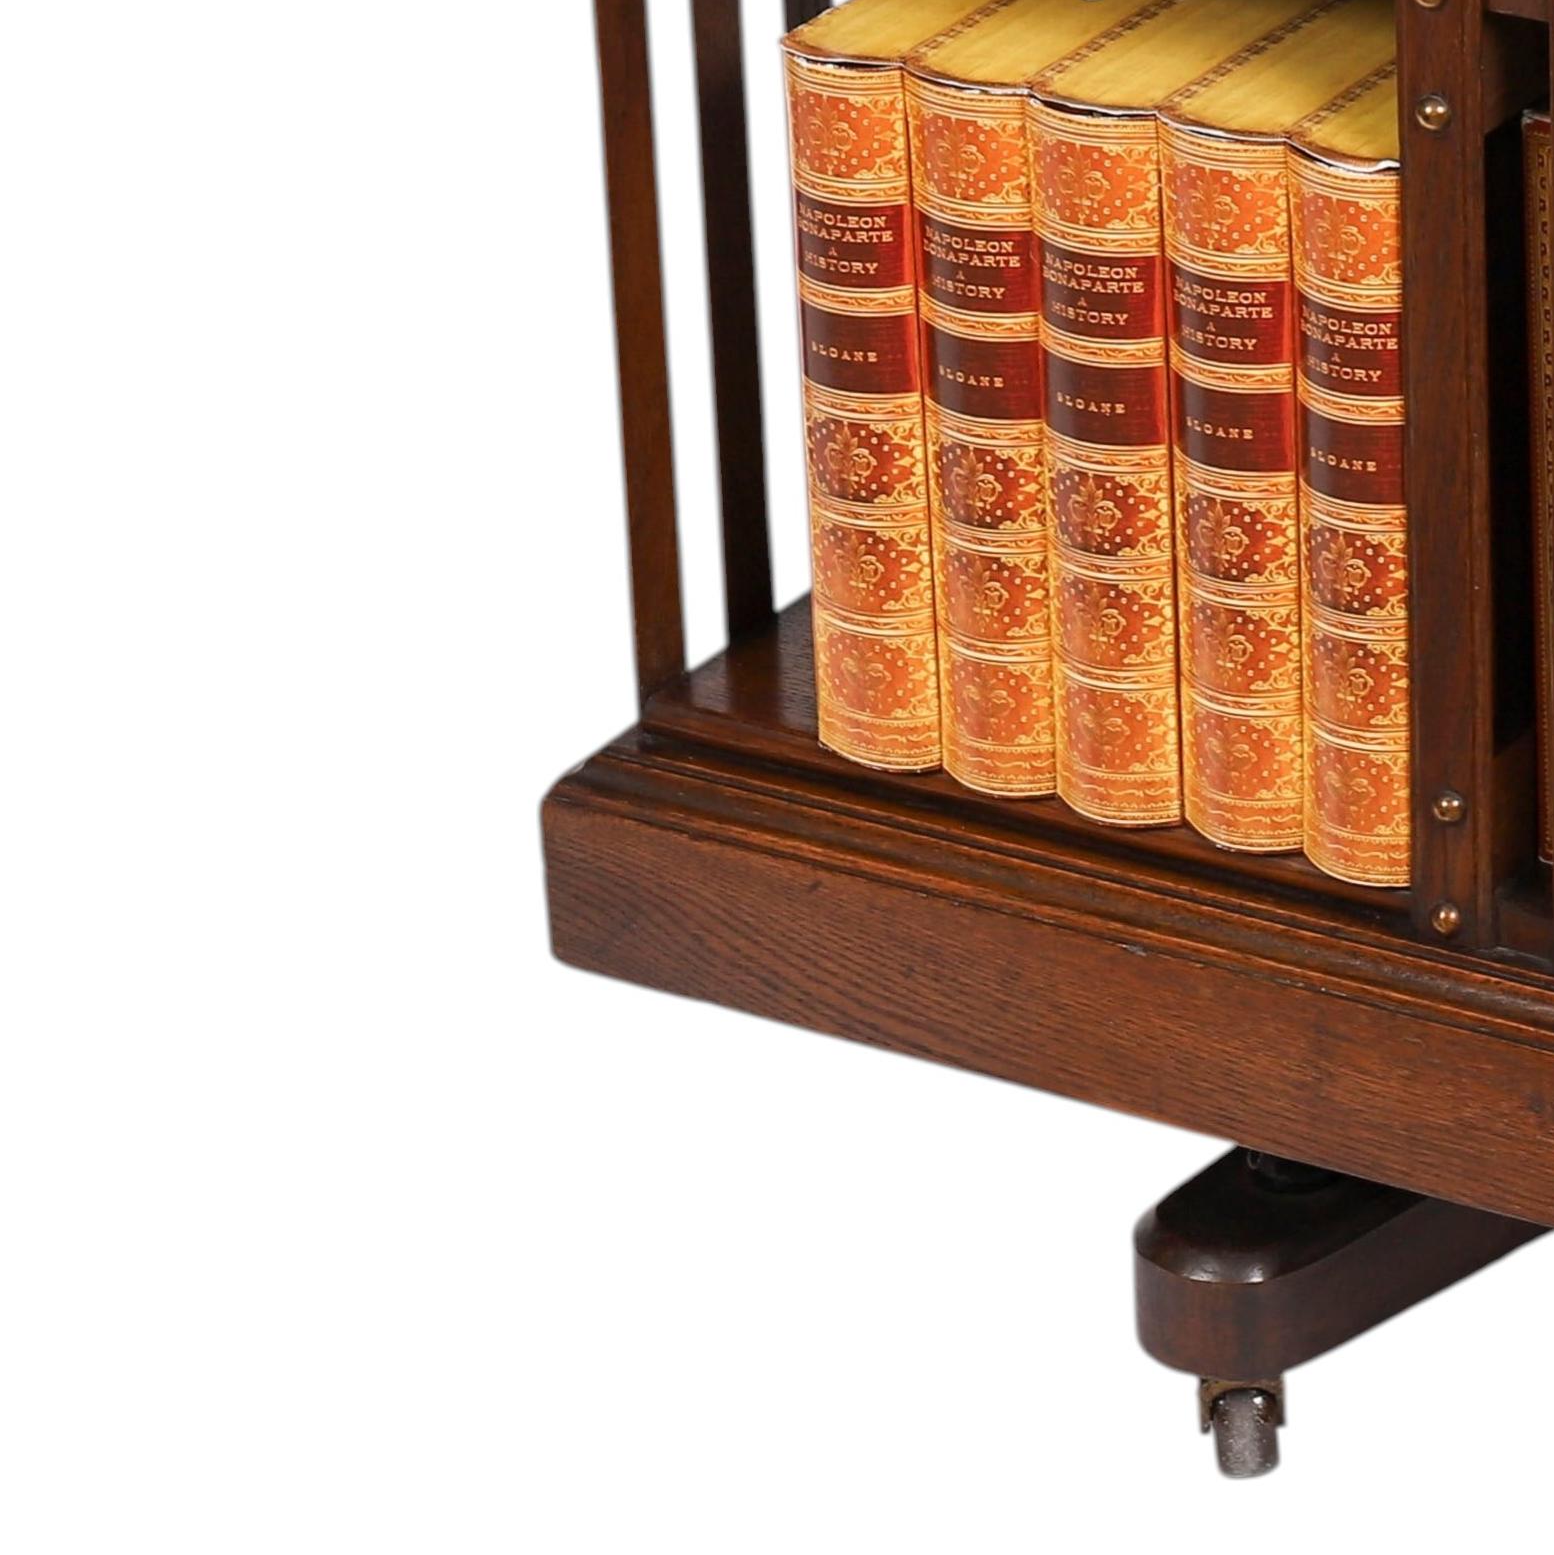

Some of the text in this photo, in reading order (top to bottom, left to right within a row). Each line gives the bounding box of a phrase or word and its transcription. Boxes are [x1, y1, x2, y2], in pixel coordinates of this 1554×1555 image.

[799, 202, 887, 229] NAPOLEON
[925, 225, 1014, 253] NAPOLEON
[805, 250, 879, 274] HISTORY
[1045, 251, 1138, 279] NAPOLEON
[932, 274, 1006, 299] HISTORY
[1043, 264, 1145, 294] BONAPARTE
[1175, 275, 1267, 304] NAPOLEON
[1051, 301, 1129, 326] HISTORY
[1302, 304, 1393, 336] NAPOLEON
[1181, 325, 1258, 351] HISTORY
[1306, 354, 1383, 383] HISTORY
